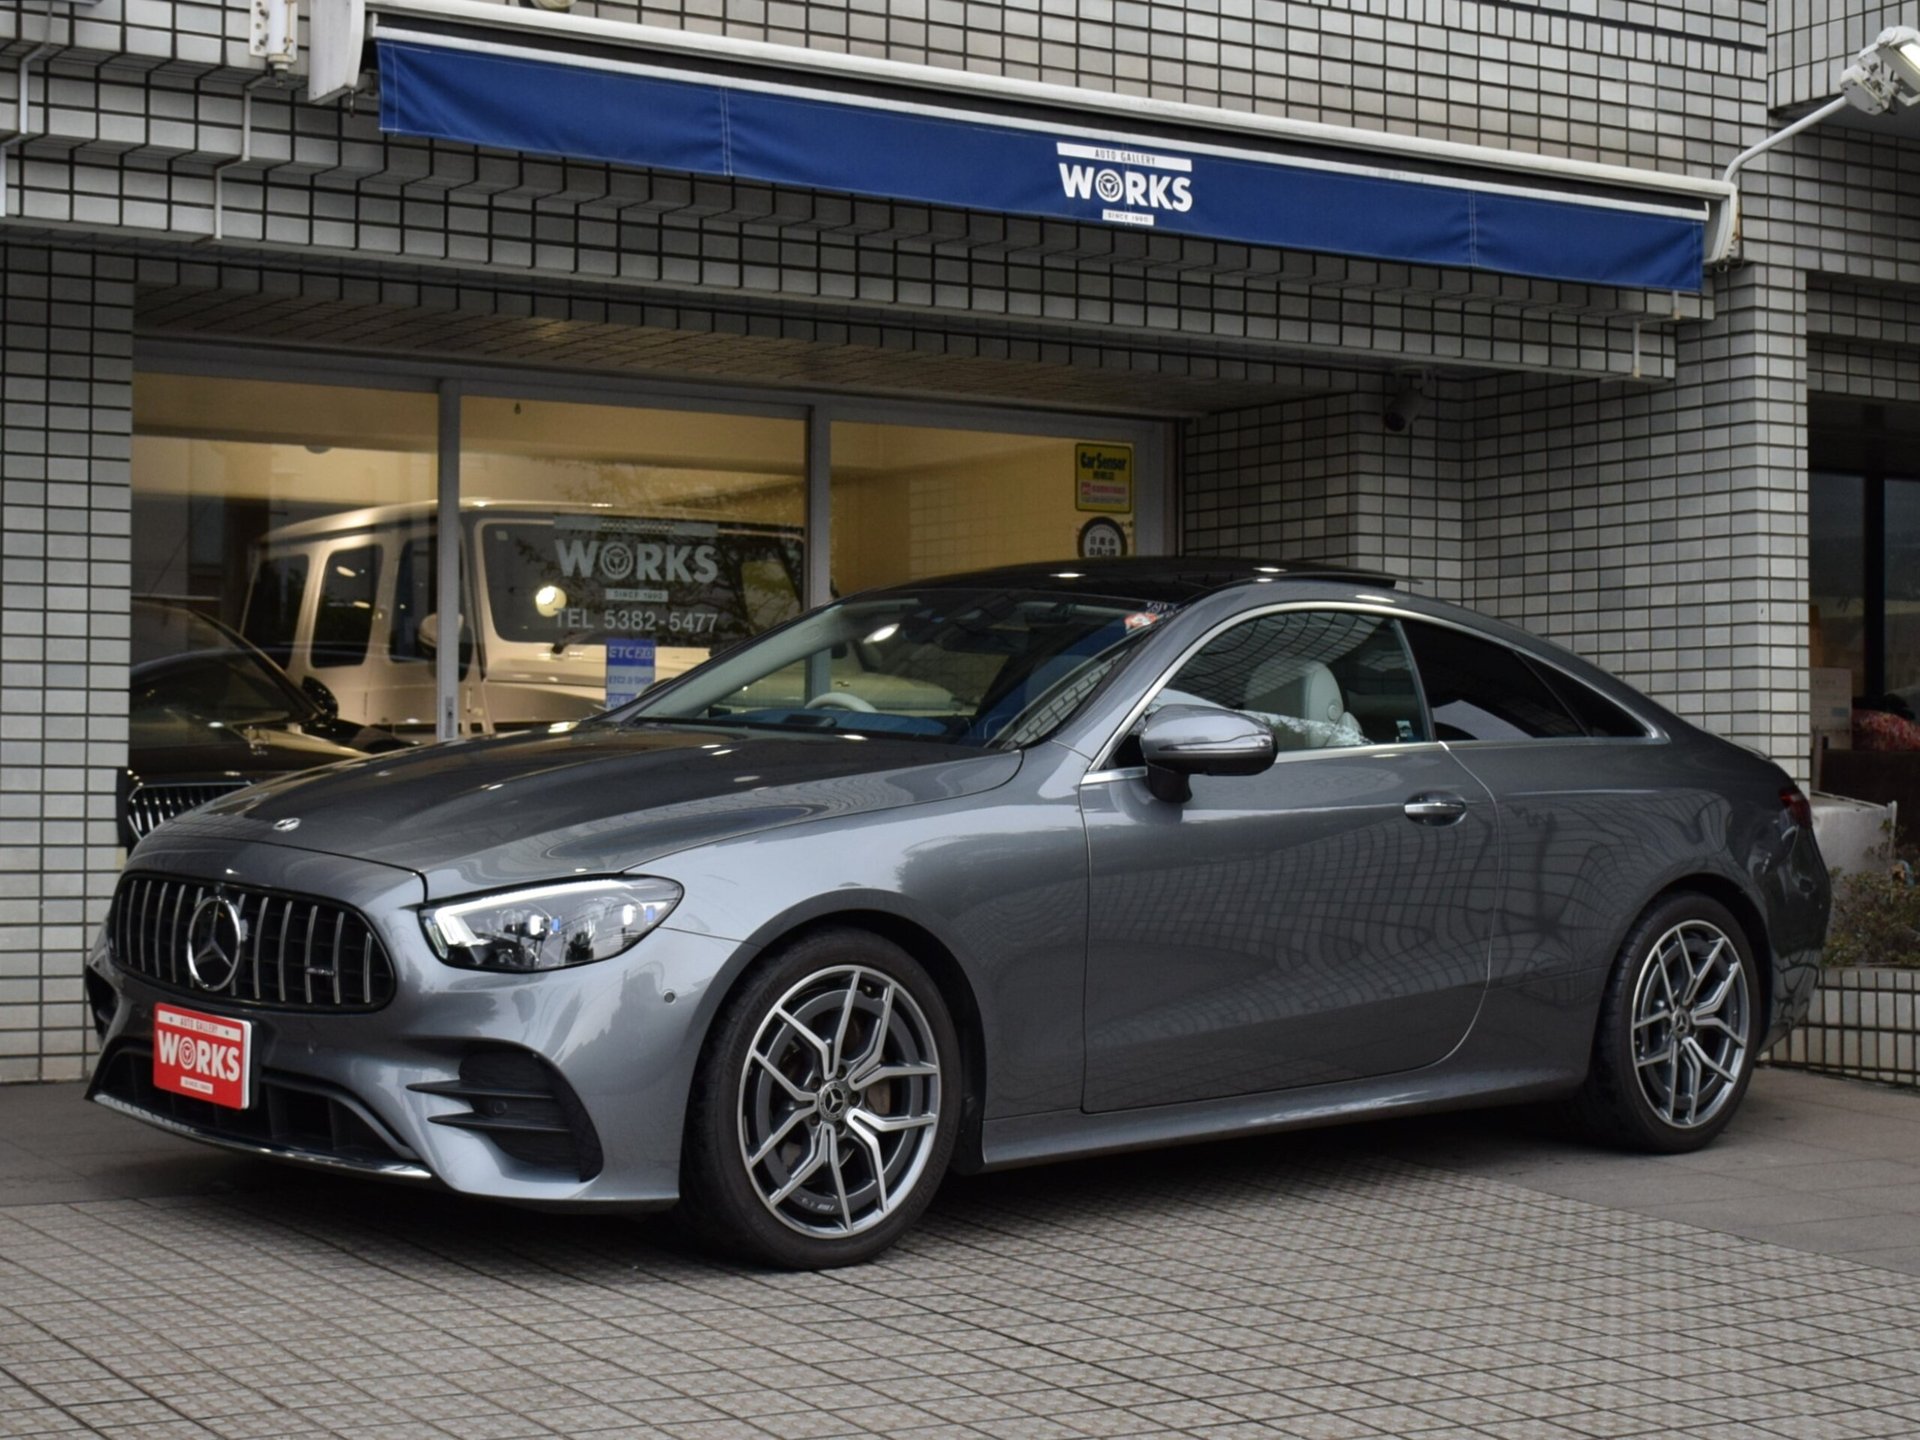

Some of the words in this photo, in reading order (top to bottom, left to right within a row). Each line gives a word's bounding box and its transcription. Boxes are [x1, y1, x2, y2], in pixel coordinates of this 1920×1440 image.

[1095, 149, 1117, 161] AUTO
[1120, 152, 1156, 166] GALLERY
[1058, 162, 1193, 213] WORKS
[554, 539, 718, 584] WORKS
[553, 607, 594, 629] TEL
[603, 609, 719, 633] 5382-5477
[180, 1016, 194, 1029] AUTO
[196, 1020, 218, 1034] GALLERY
[157, 1029, 240, 1082] WORKS
